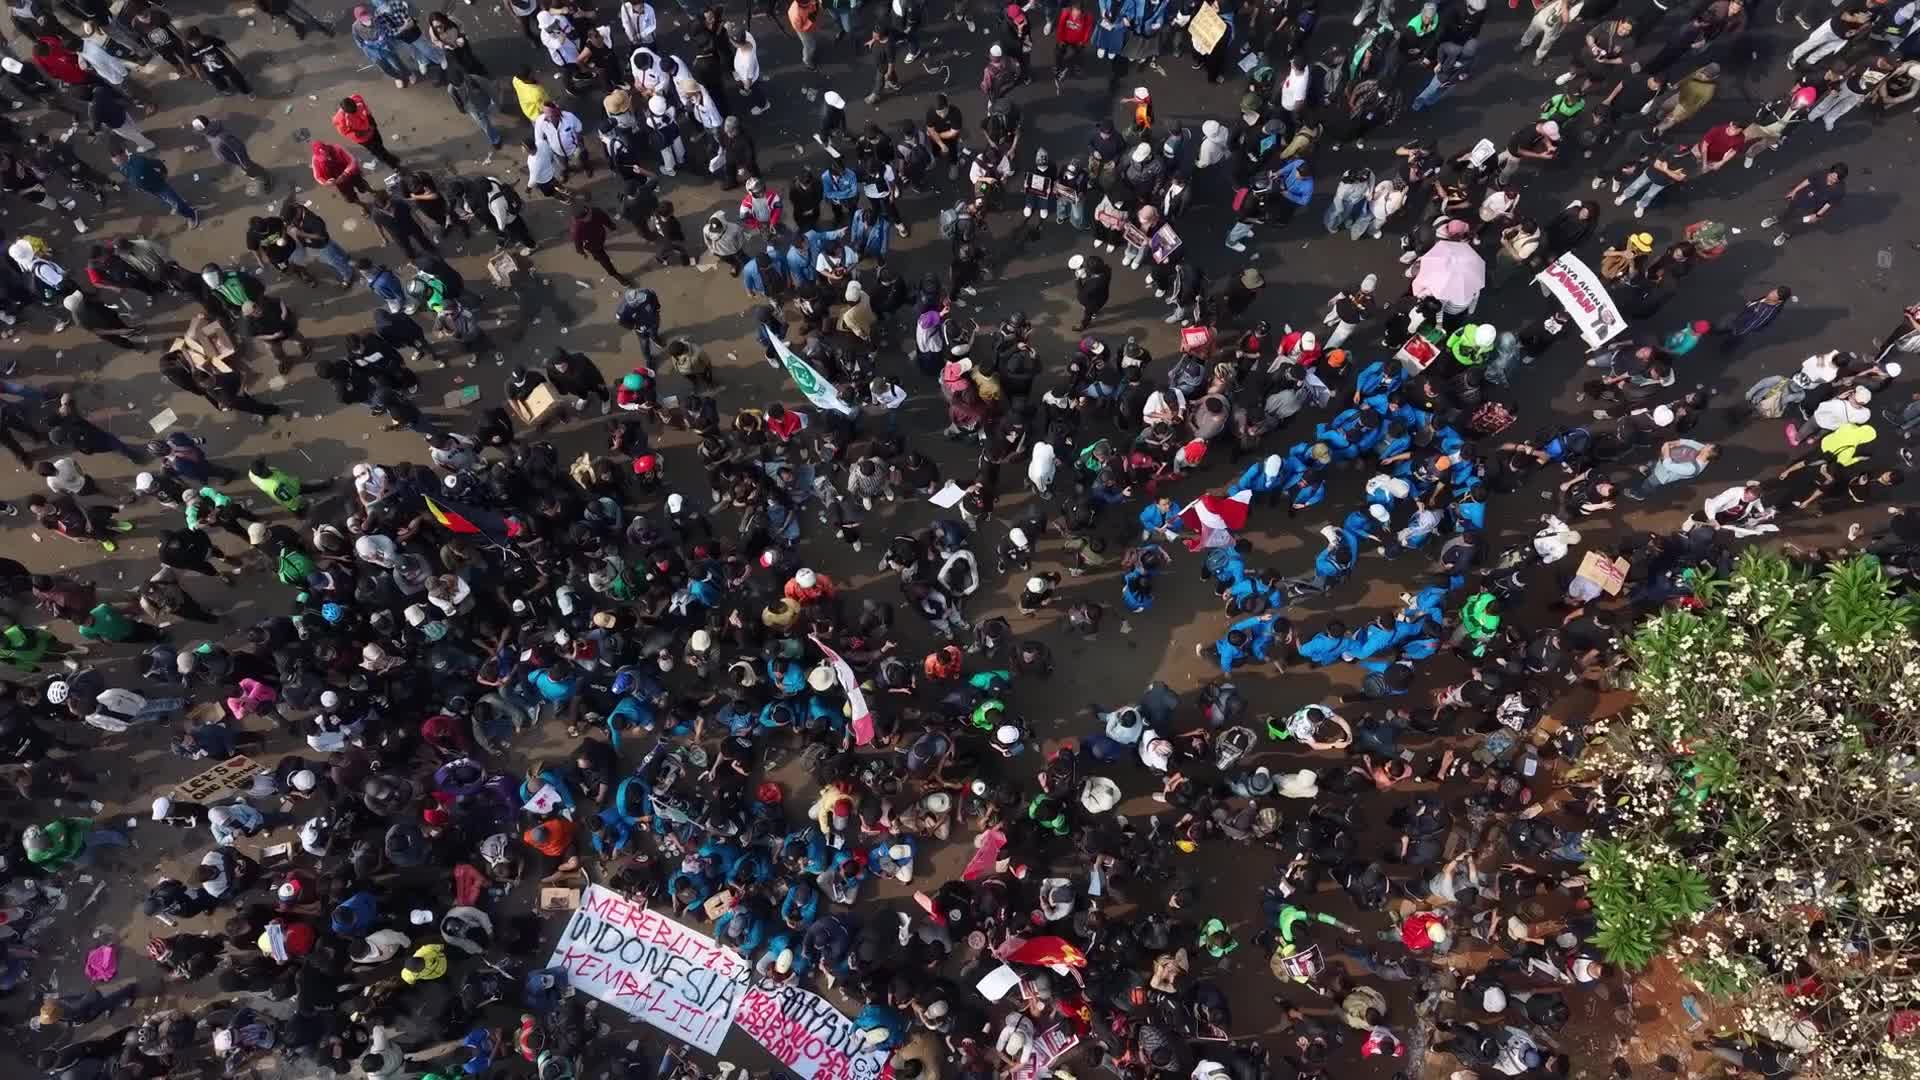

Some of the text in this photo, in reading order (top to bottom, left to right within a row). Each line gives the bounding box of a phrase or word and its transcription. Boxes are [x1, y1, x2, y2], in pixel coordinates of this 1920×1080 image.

[1545, 264, 1596, 313] LAWAN
[1554, 260, 1601, 306] SAYA AKAN
[585, 891, 706, 961] MEREBUT
[742, 988, 825, 1060] PRABOWO
